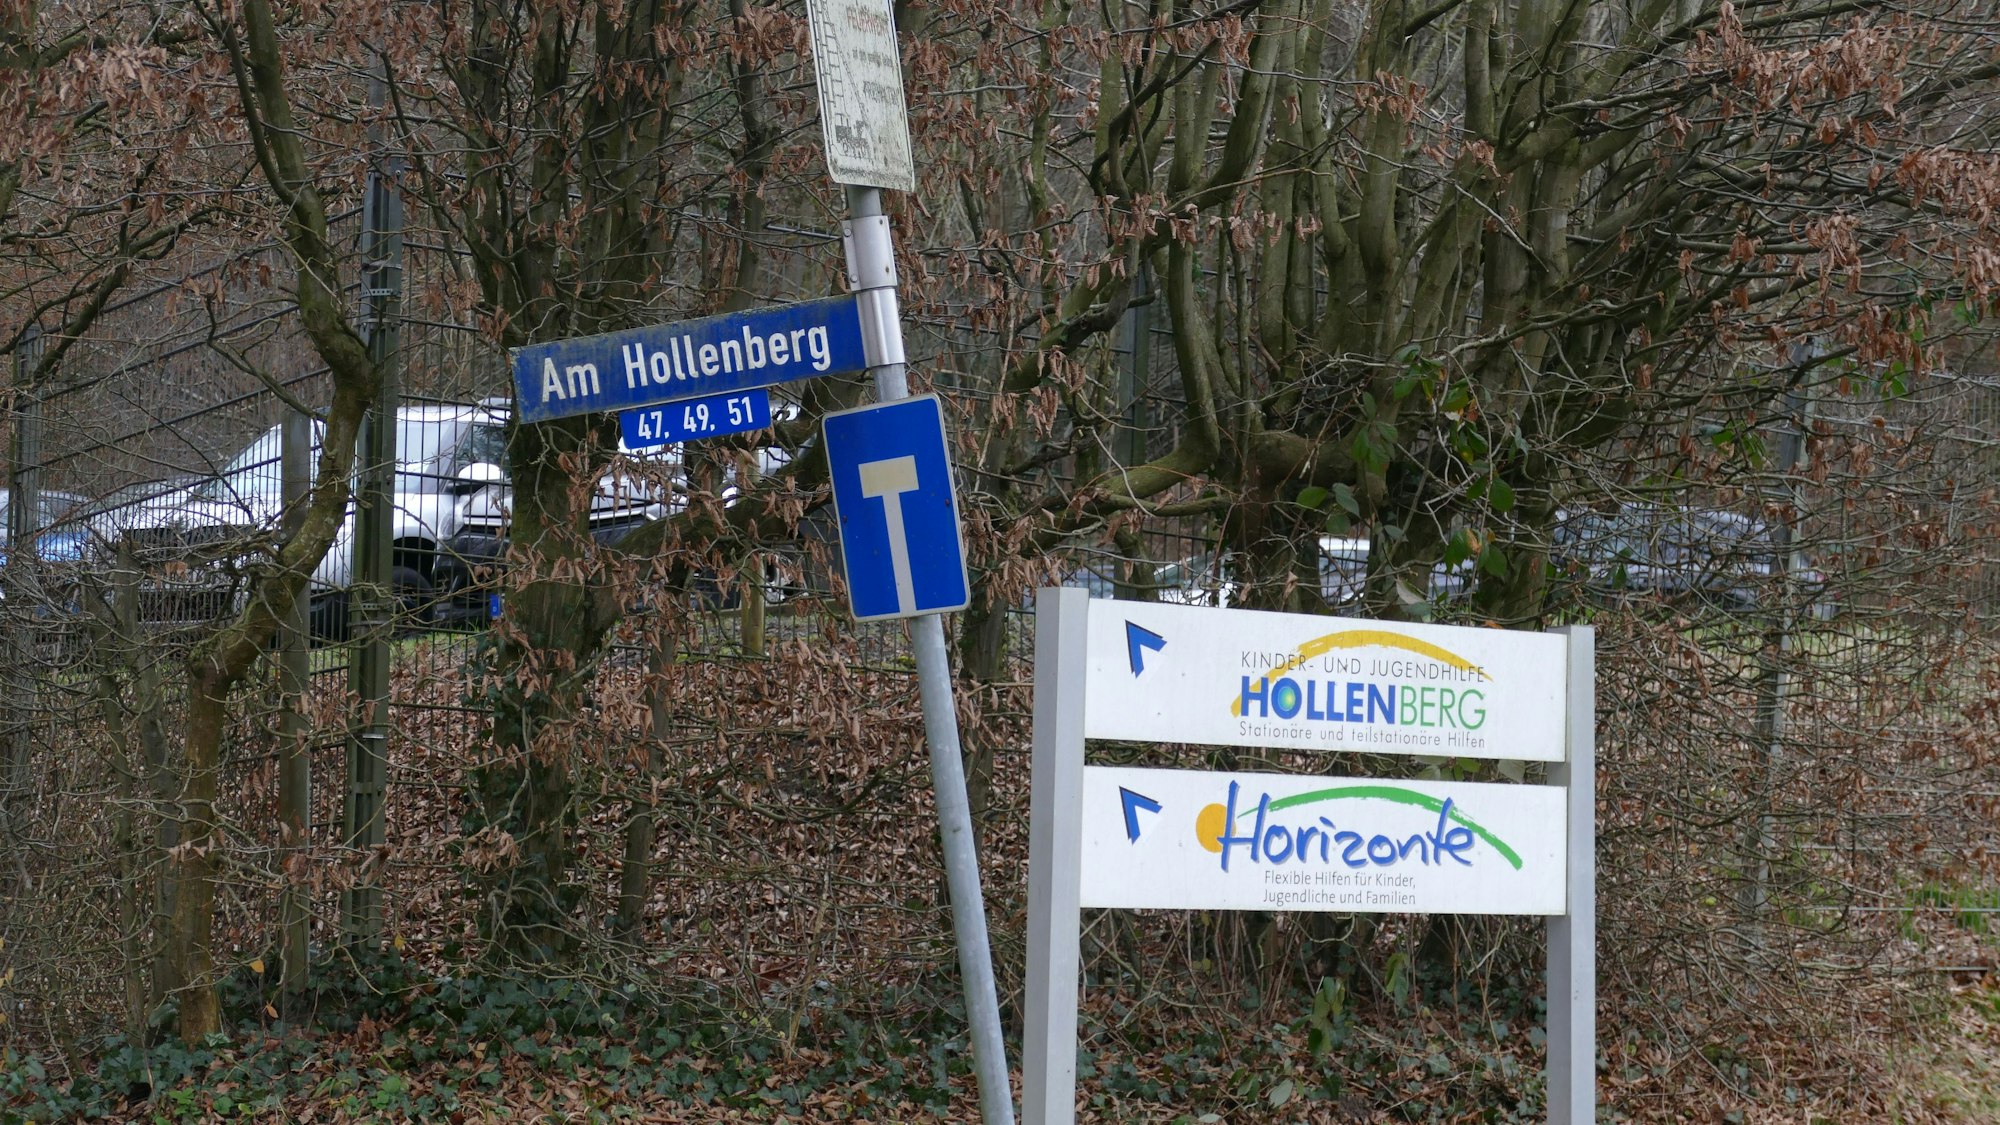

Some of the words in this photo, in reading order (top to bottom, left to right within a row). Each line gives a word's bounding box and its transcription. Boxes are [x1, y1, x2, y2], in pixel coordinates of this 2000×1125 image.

[541, 357, 600, 403] Am
[622, 325, 832, 390] Hollenberg
[638, 410, 670, 440] 47,
[683, 402, 716, 433] 49,
[728, 396, 754, 426] 51
[1241, 651, 1314, 671] KINDER-
[1324, 656, 1361, 675] UND
[1370, 659, 1485, 682] JUGENDHILFE
[1240, 675, 1487, 730] HOLLENBERG
[1239, 720, 1312, 740] Stationäre
[1320, 725, 1344, 742] und
[1352, 726, 1441, 746] teilstationäre
[1447, 731, 1485, 748] Hilfen
[1217, 779, 1475, 873] Horizonte
[1263, 889, 1336, 907] Jugendliche
[1339, 890, 1363, 904] und
[1366, 891, 1416, 905] Familien
[1264, 870, 1311, 885] Flexible
[1315, 871, 1351, 886] Hilfen
[1355, 872, 1373, 887] für
[1375, 873, 1416, 889] Kinder,
